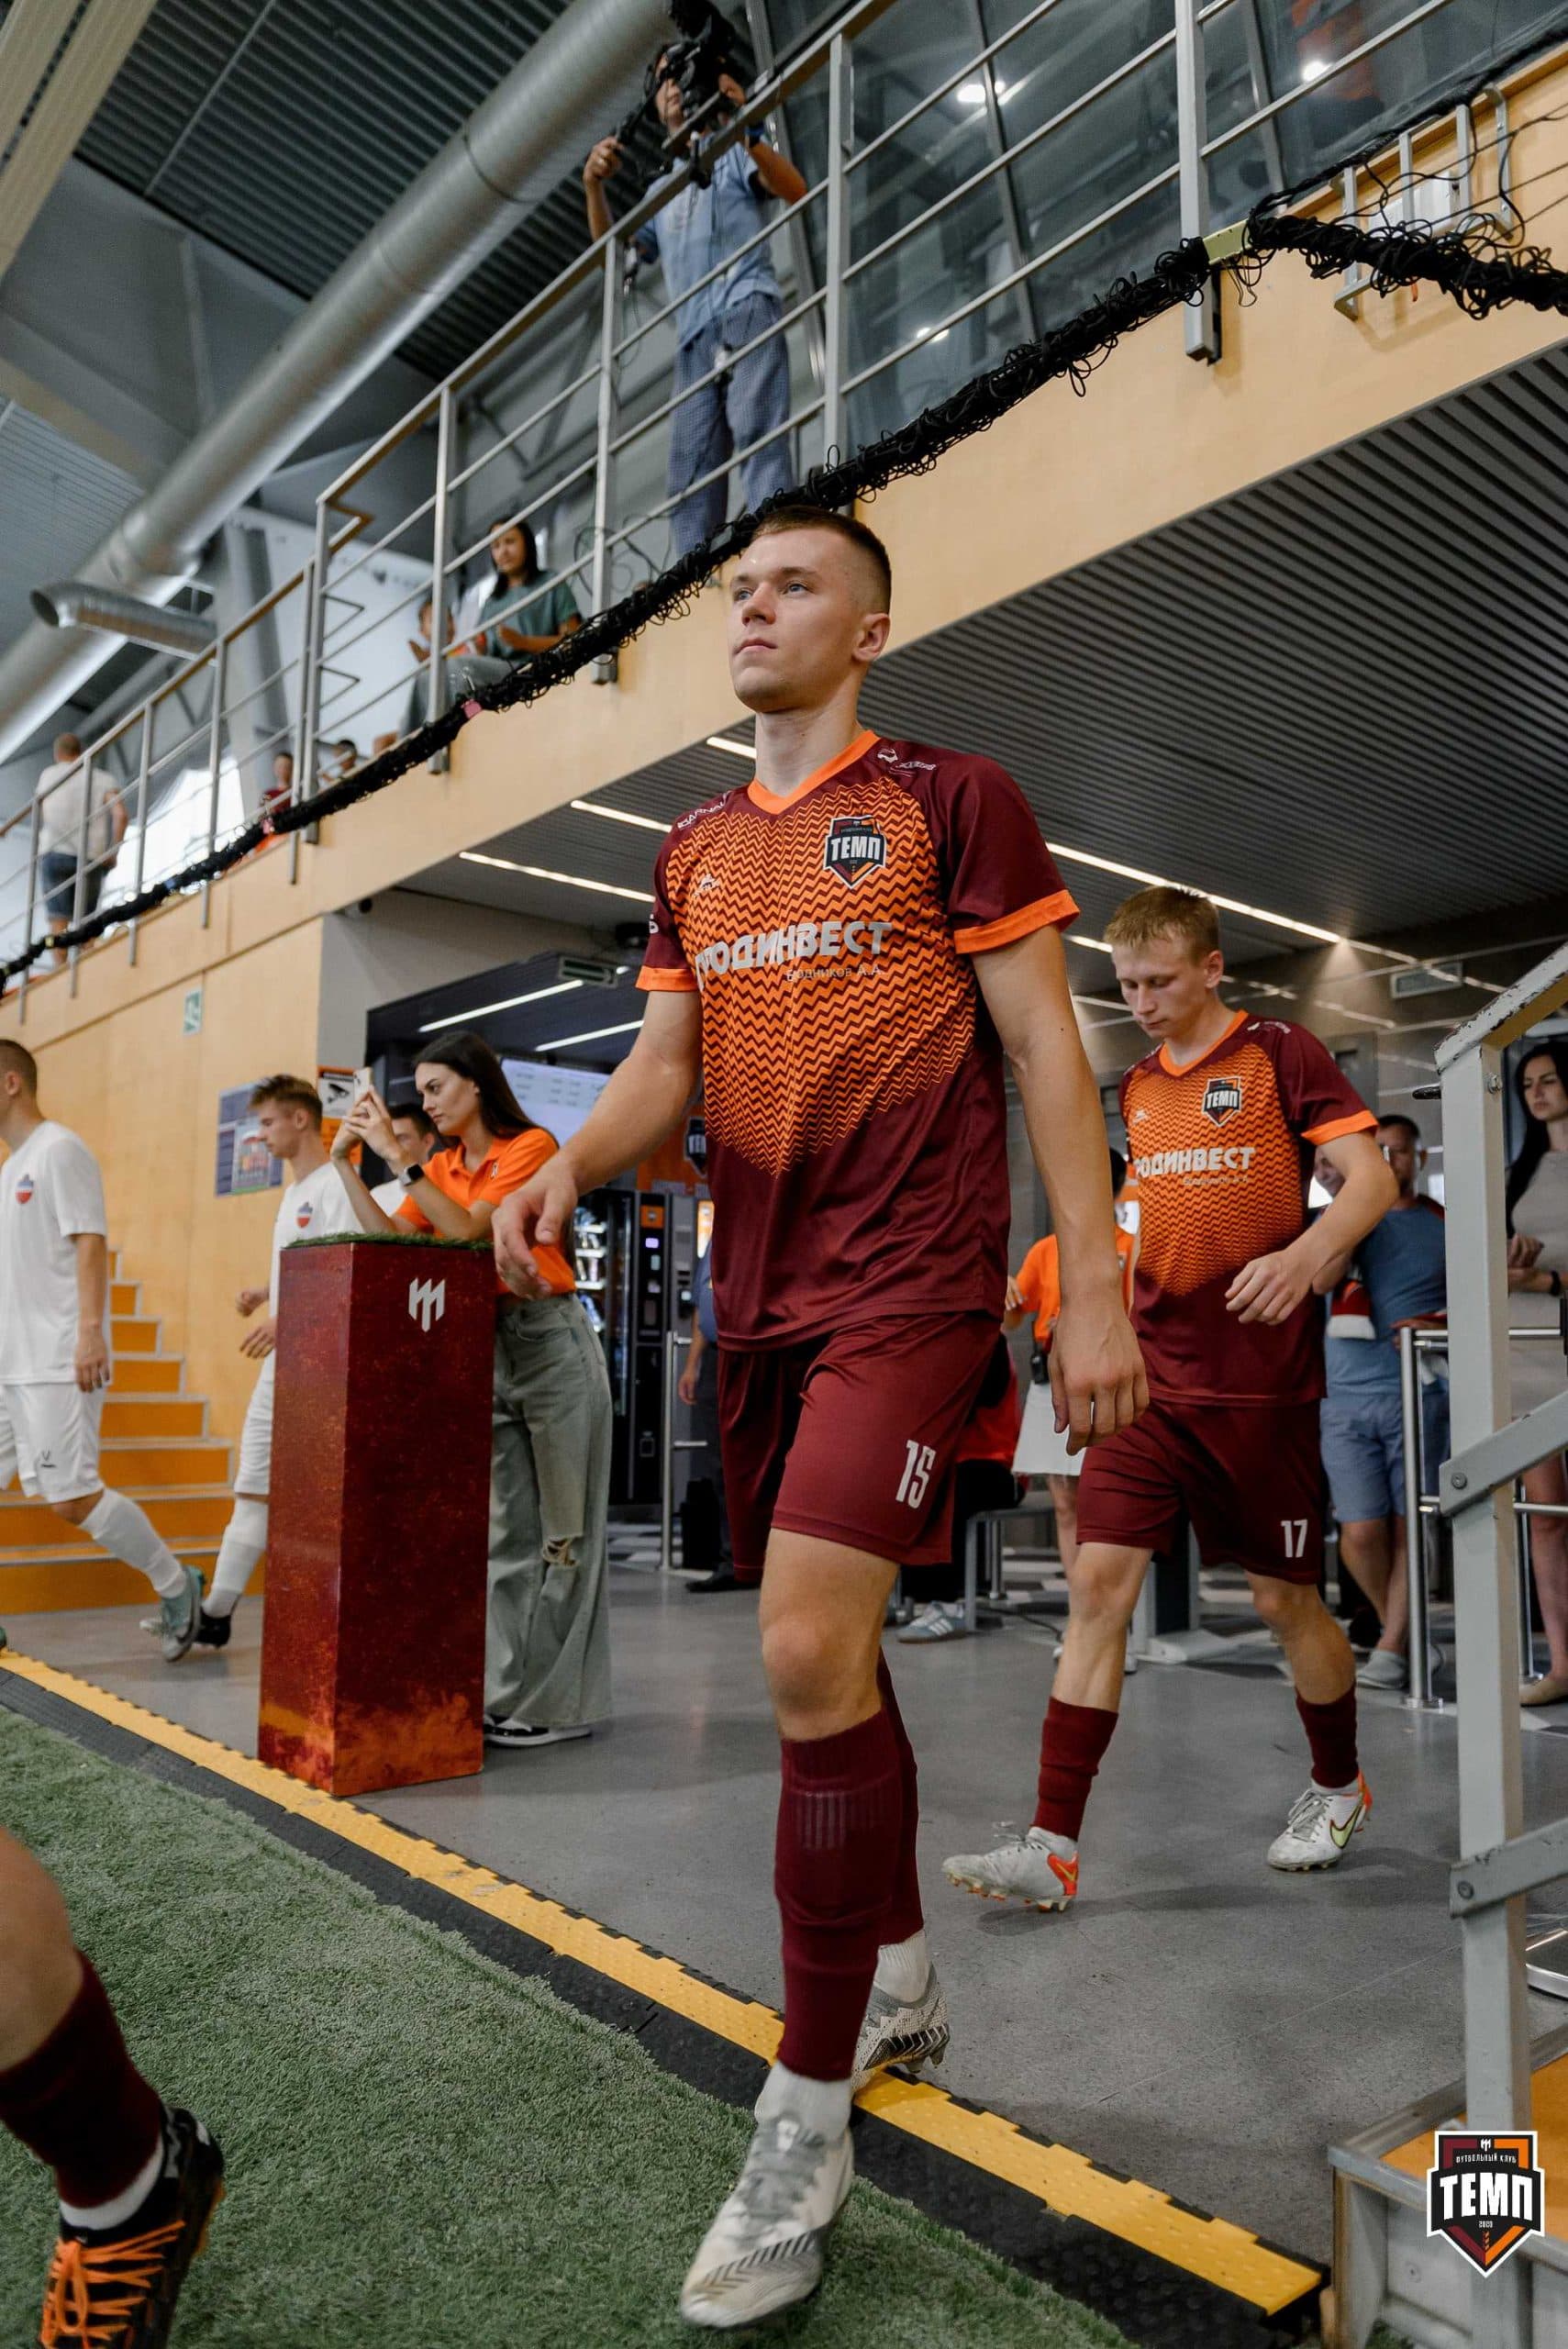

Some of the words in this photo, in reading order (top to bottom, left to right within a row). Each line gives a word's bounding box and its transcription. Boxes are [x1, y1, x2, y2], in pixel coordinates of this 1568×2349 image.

[830, 835, 881, 862] ТЕМП
[1207, 1090, 1239, 1109] ТЕМП
[895, 1439, 937, 1509] 15
[1280, 1519, 1308, 1558] 17
